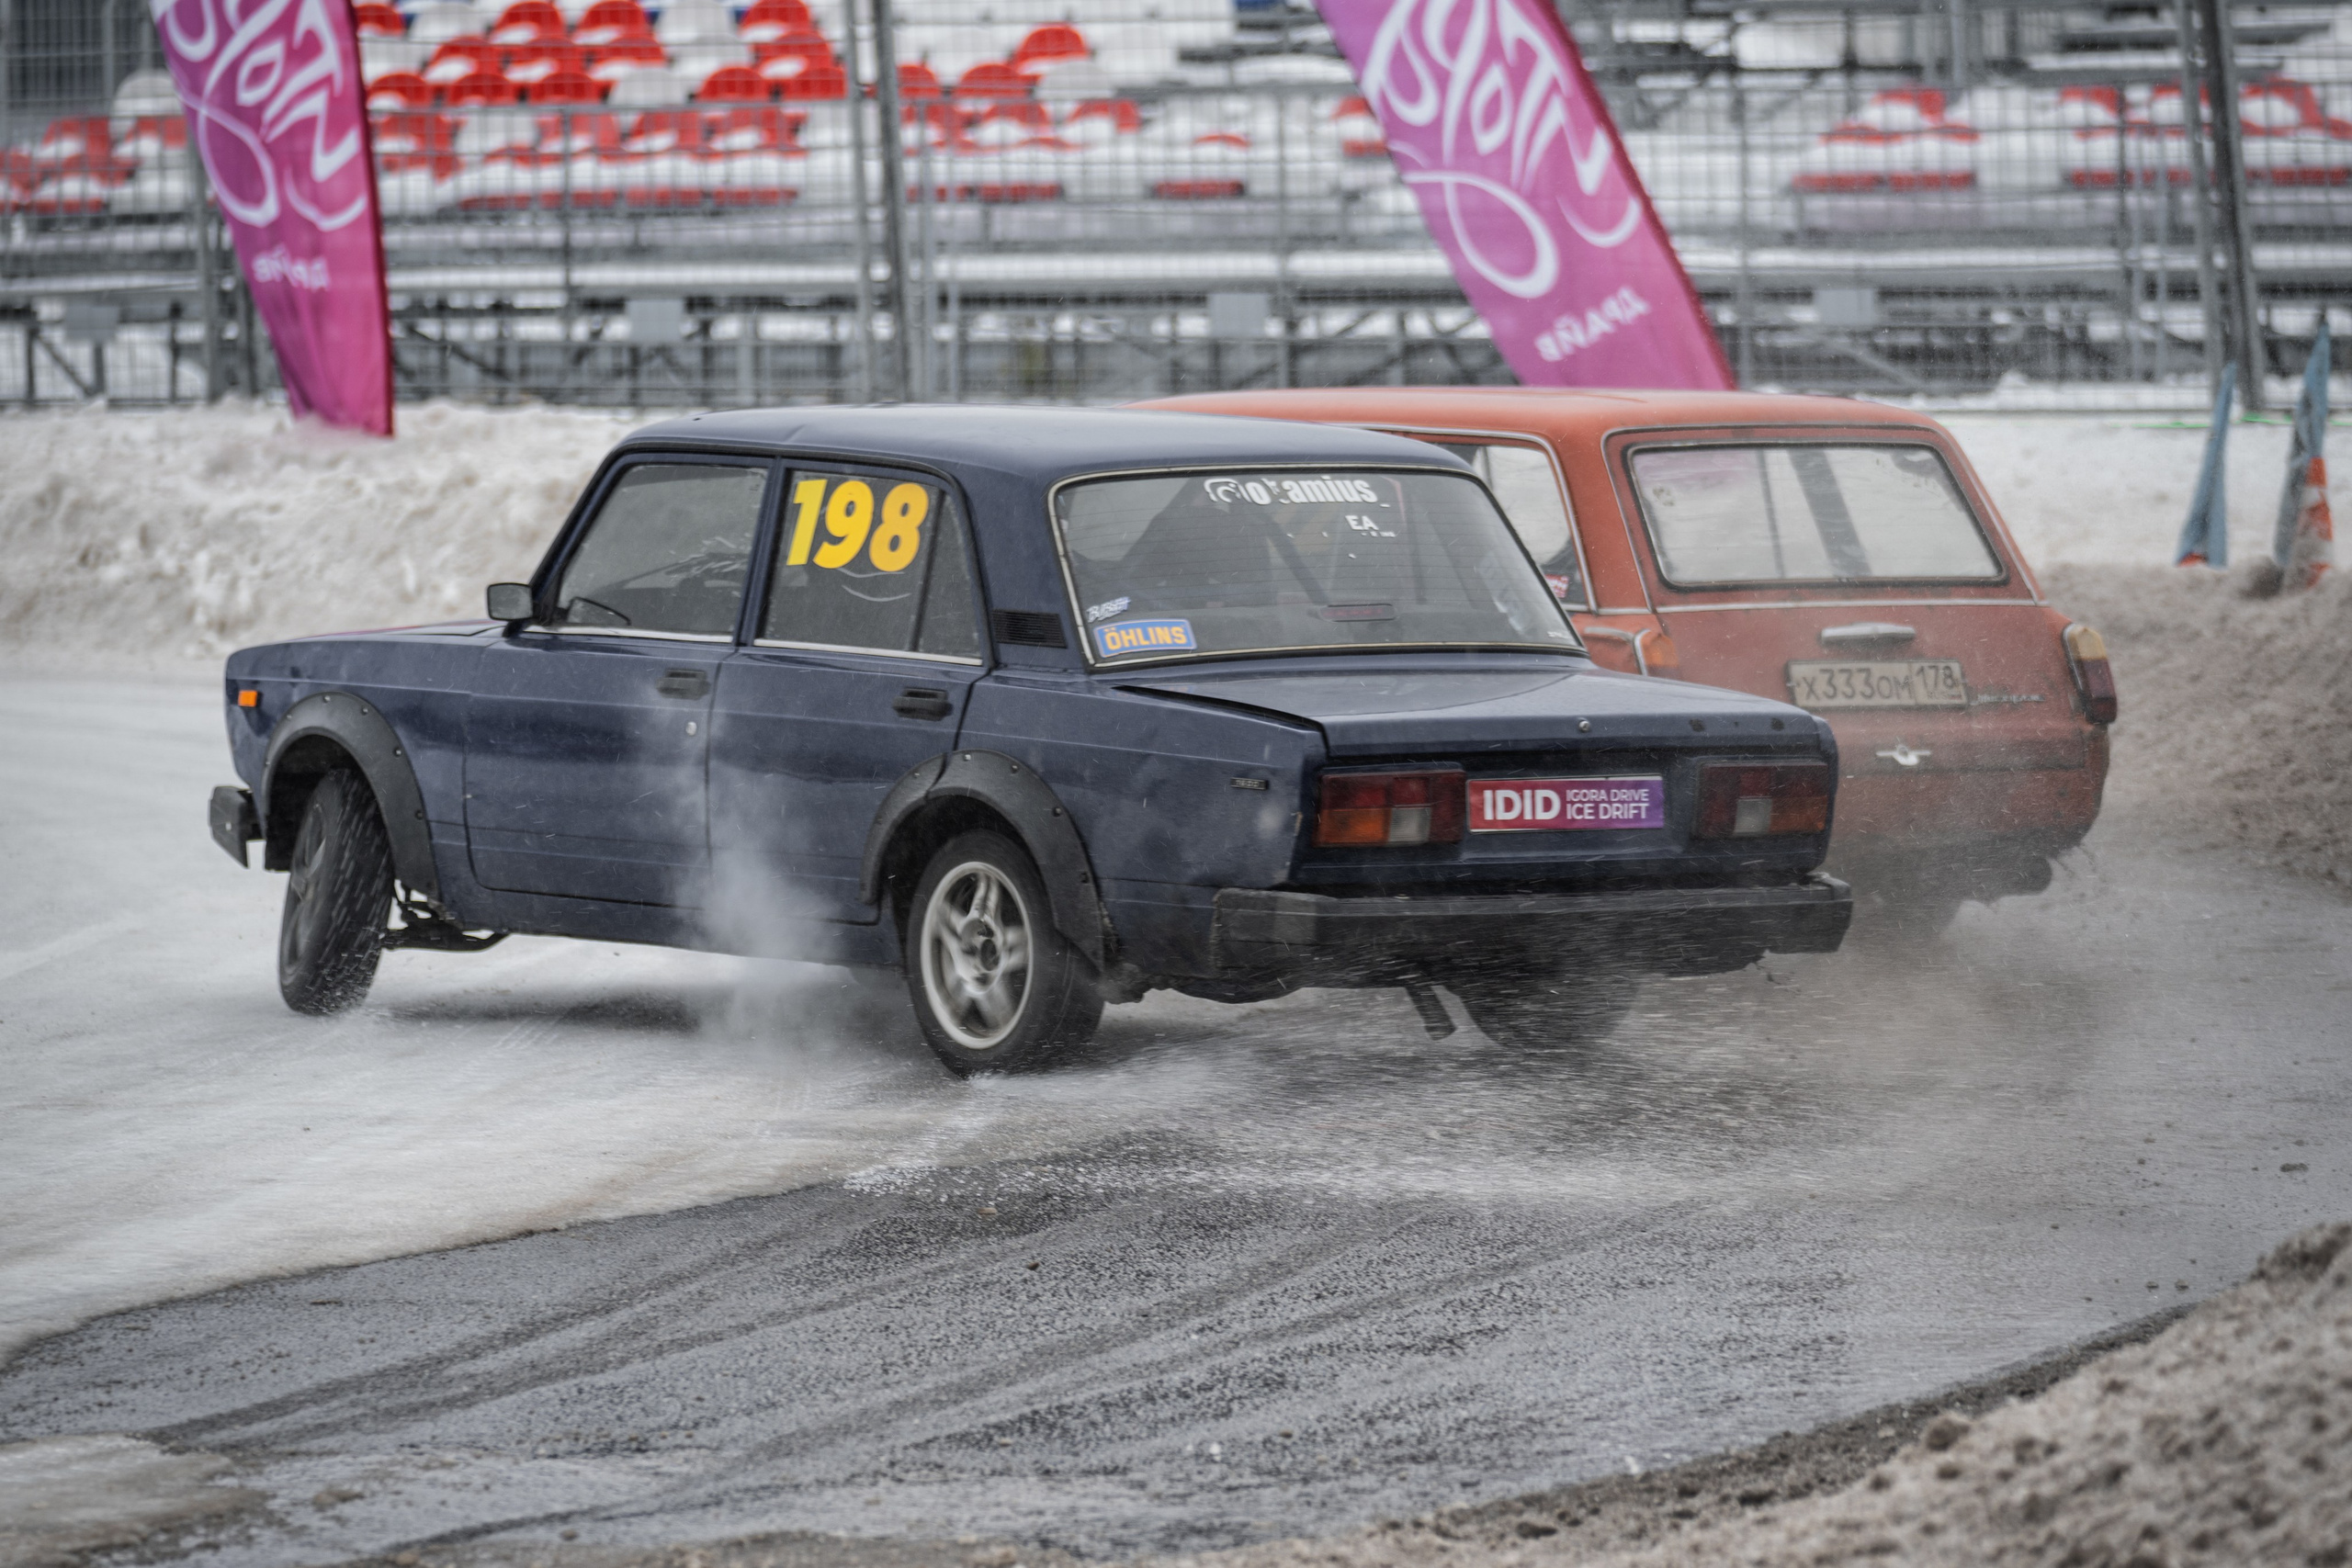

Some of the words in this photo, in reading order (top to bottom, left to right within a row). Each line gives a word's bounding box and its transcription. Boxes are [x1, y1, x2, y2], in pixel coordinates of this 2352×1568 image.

[786, 479, 929, 572] 198
[1104, 626, 1188, 650] ÖHLINS
[1916, 665, 1956, 688] 178
[1483, 789, 1561, 820] IDID
[1566, 789, 1608, 802] IGORA
[1610, 789, 1649, 802] DRIVE
[1566, 803, 1595, 819] ICE
[1599, 803, 1650, 819] DRIFT
